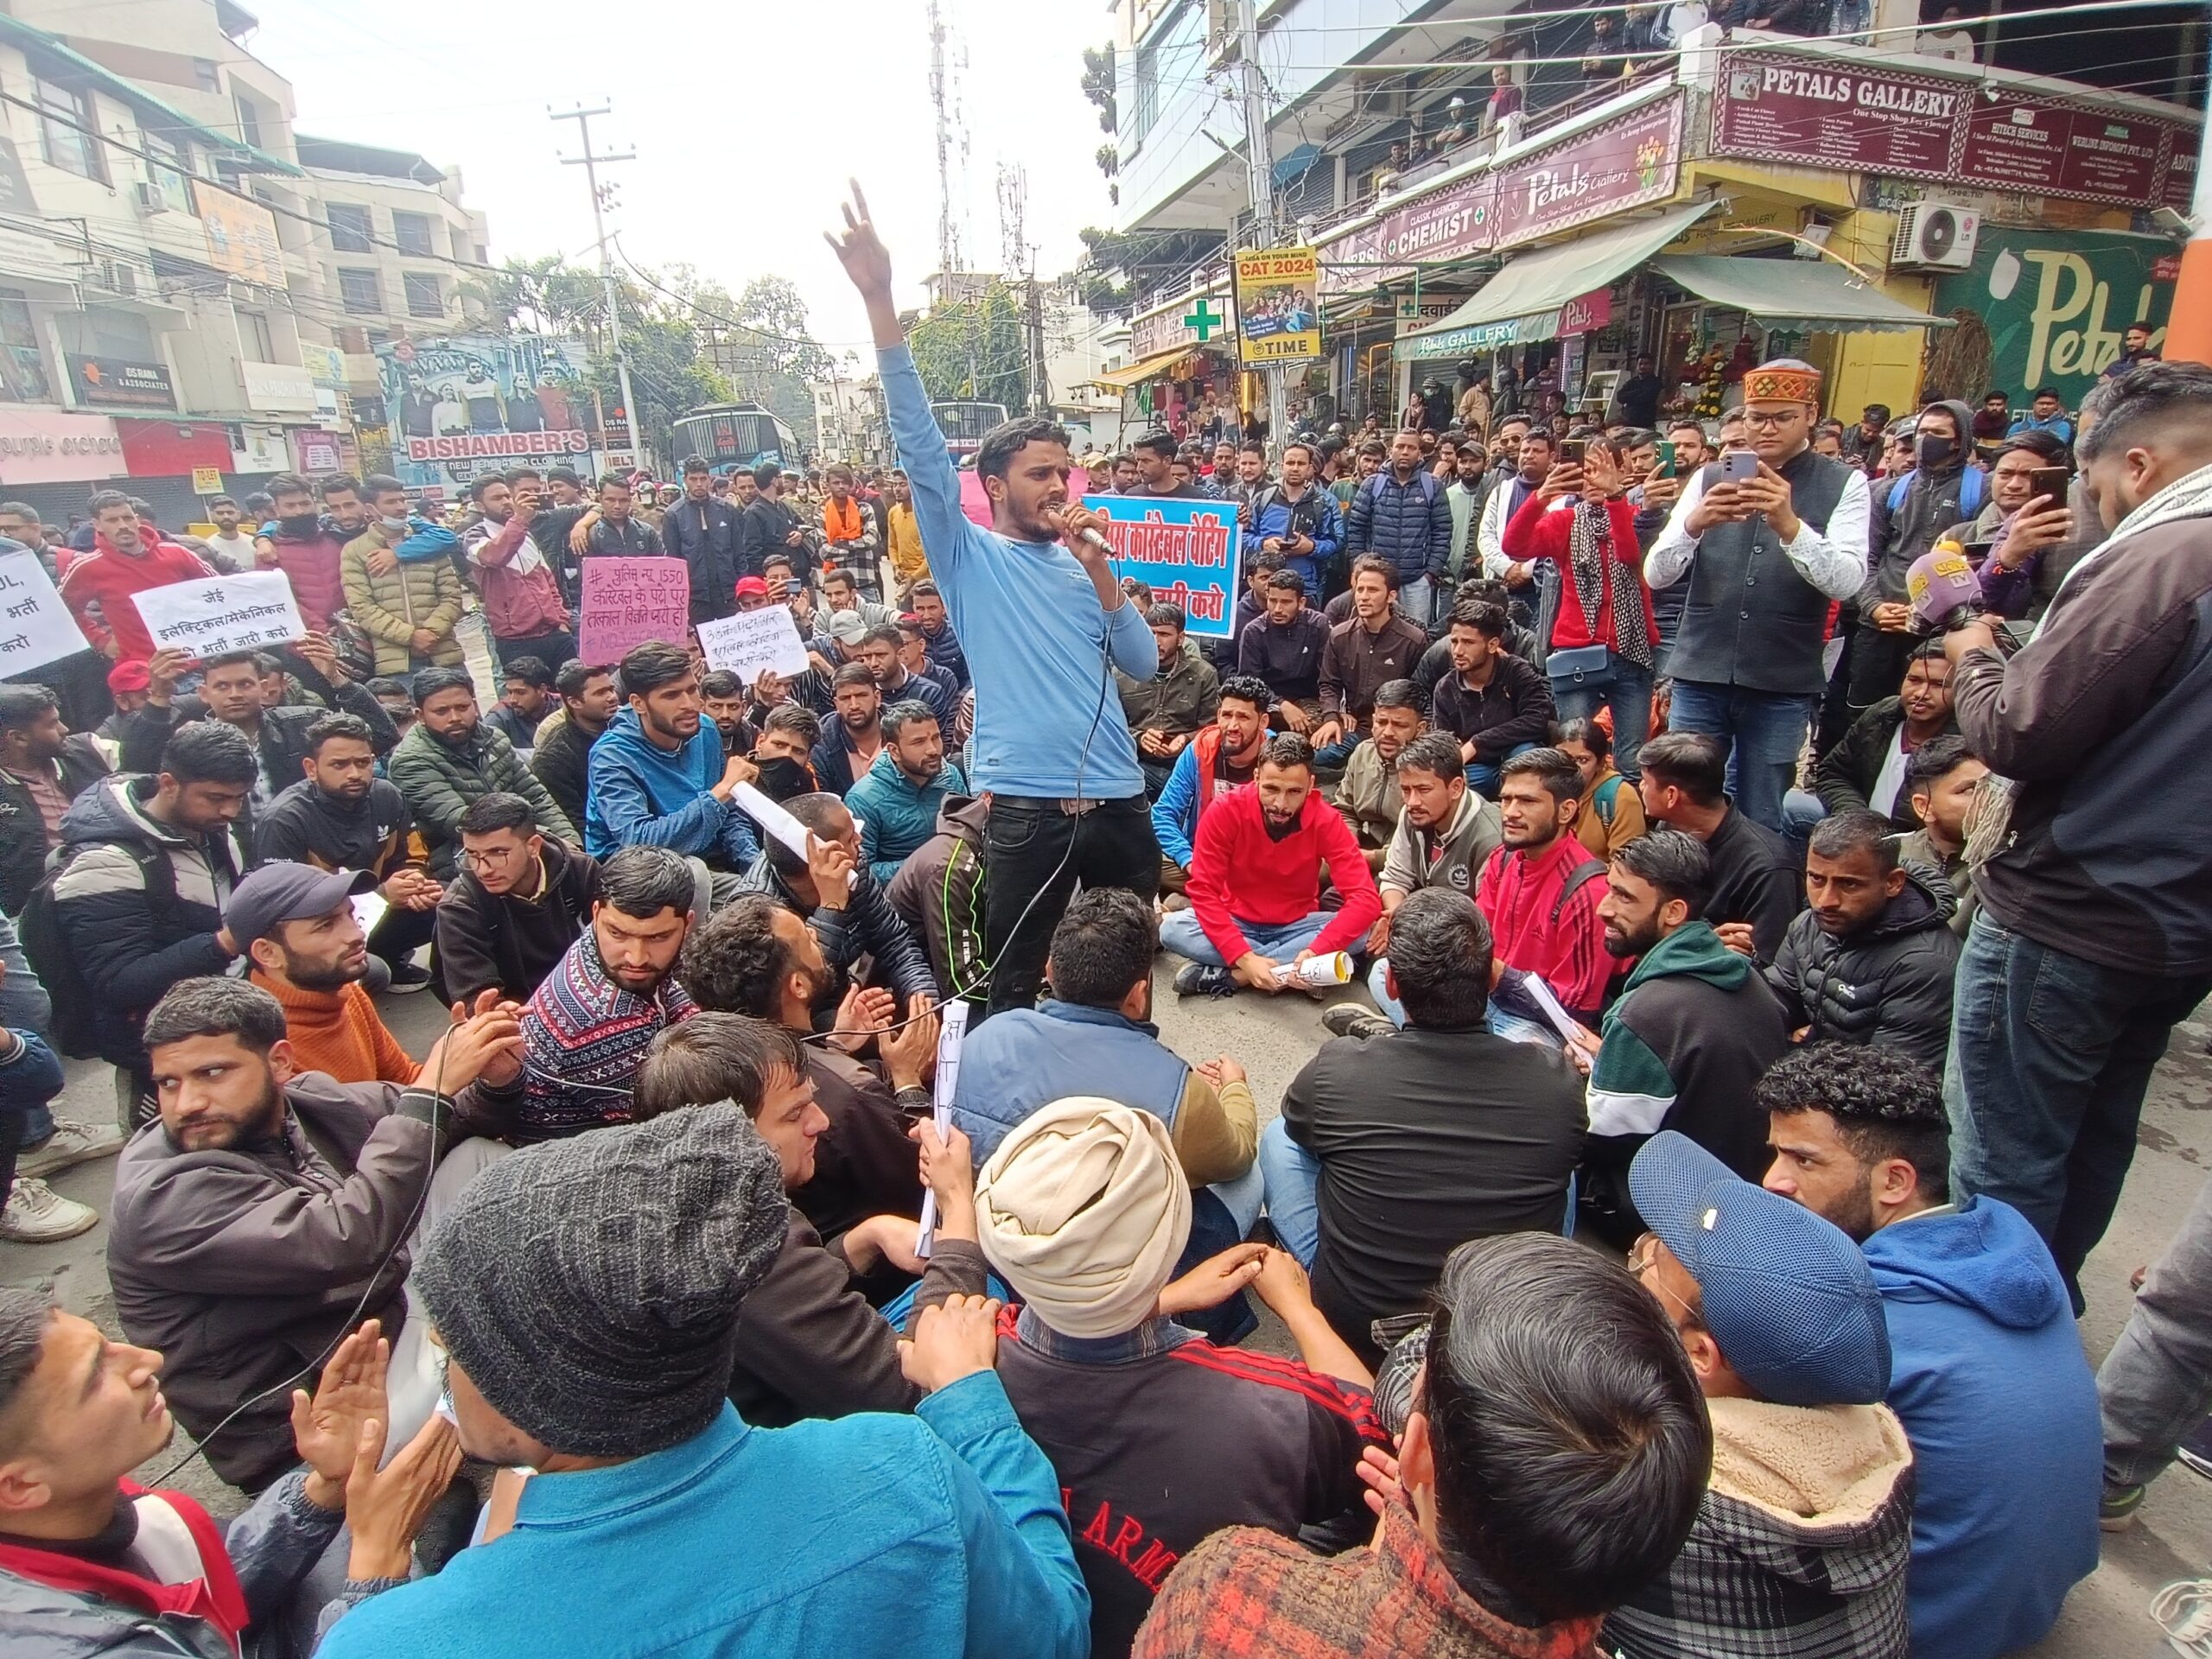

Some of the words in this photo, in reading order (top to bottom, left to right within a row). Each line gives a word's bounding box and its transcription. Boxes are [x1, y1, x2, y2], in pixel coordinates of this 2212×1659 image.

[1763, 67, 1851, 102] PETALS
[1858, 81, 1956, 118] GALLERY
[1853, 108, 1869, 118] One
[1871, 110, 1888, 122] Stop
[1889, 114, 1909, 124] Shop
[2017, 127, 2049, 142] SERVICES
[1523, 162, 1590, 215] Petals
[1590, 168, 1630, 190] Gallery
[1397, 207, 1473, 255] CHEMIST
[1239, 262, 1269, 276] CAT
[1274, 258, 1315, 274] 2024
[1420, 297, 1467, 317] दवाई
[1566, 302, 1592, 330] Petals
[2024, 249, 2168, 391] Peta
[1447, 321, 1516, 346] GALLERY
[124, 379, 169, 391] ASSOCIATES
[408, 430, 589, 461] BISHAMBER'S
[429, 462, 448, 471] THE
[448, 461, 470, 470] NEW
[472, 458, 529, 470] GENERATN
[531, 456, 575, 466] CLOHING
[607, 455, 634, 467] IELT
[659, 569, 683, 585] 1550
[1950, 573, 1966, 584] TV
[201, 588, 225, 604] जेई
[1191, 583, 1224, 620] करो
[7, 596, 40, 619] भर्ती
[0, 633, 31, 653] करो
[201, 636, 229, 655] भर्ती
[233, 632, 260, 646] जारी
[265, 626, 289, 639] करो
[1083, 1501, 1179, 1594] ARM
